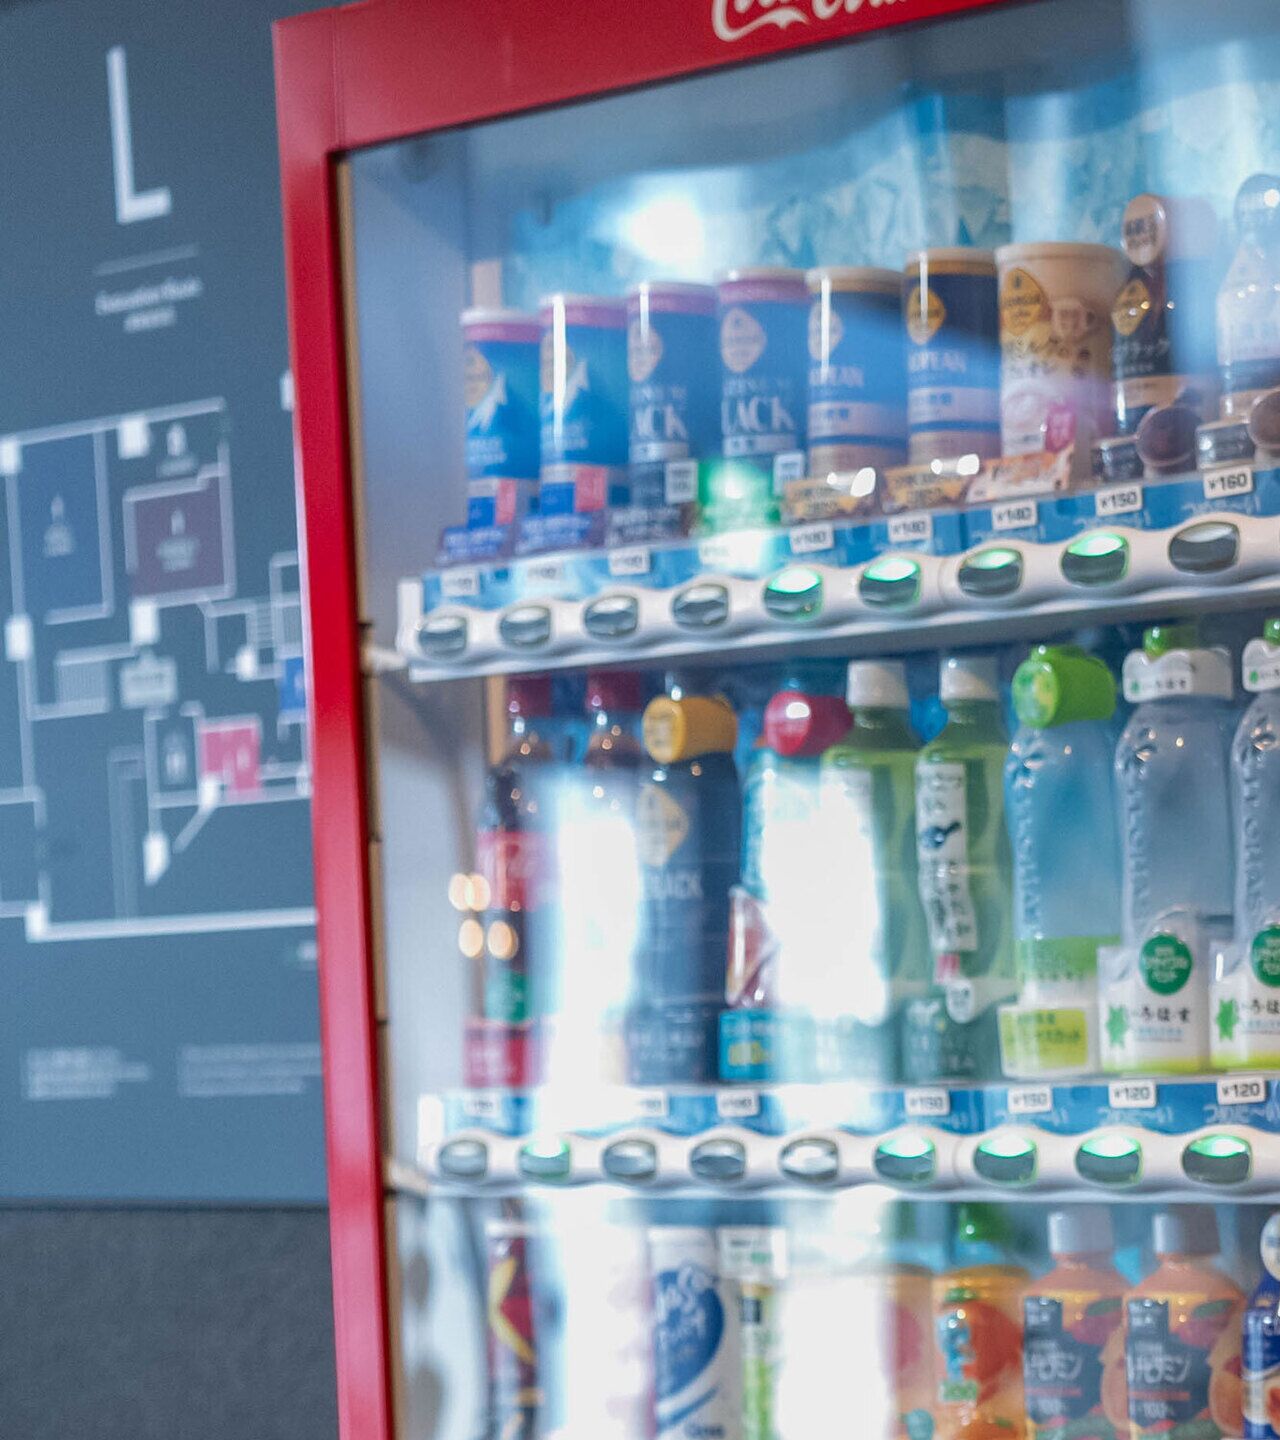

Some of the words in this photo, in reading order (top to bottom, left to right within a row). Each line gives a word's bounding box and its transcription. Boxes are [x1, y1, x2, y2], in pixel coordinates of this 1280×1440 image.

[107, 46, 172, 224] L
[1209, 474, 1247, 490] ¥160
[1113, 1085, 1150, 1100] ¥120
[1222, 1082, 1260, 1097] ¥120
